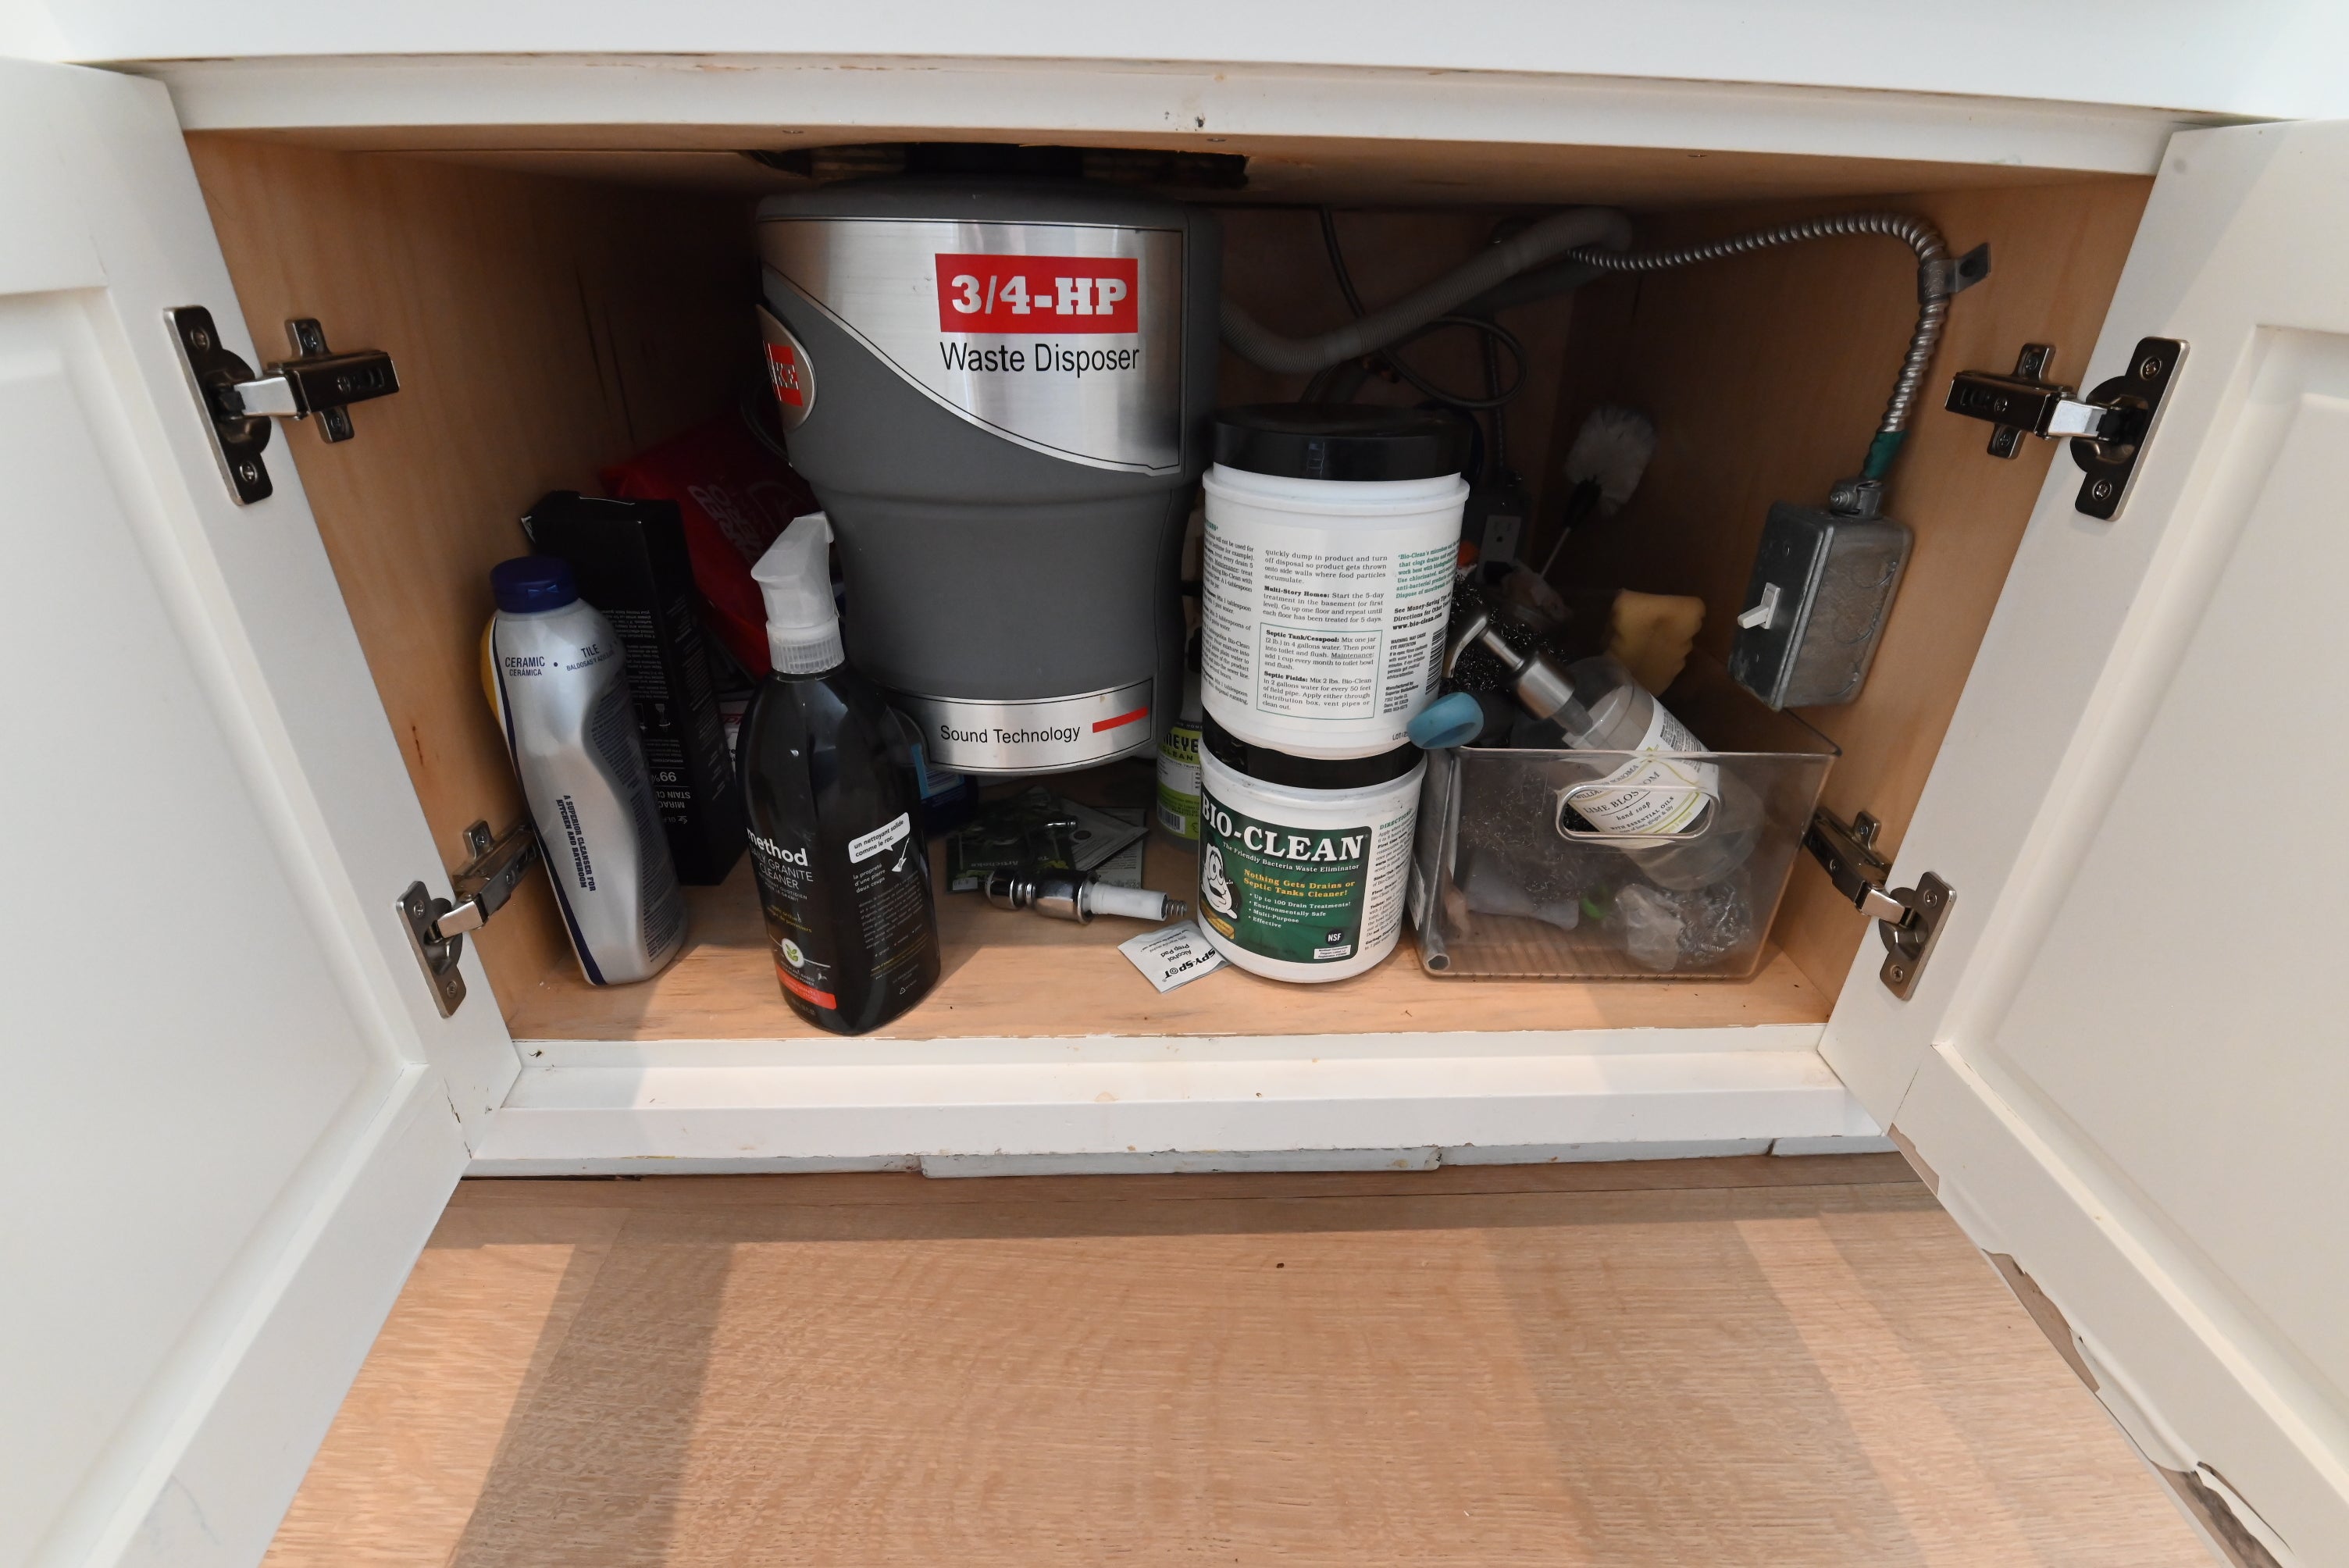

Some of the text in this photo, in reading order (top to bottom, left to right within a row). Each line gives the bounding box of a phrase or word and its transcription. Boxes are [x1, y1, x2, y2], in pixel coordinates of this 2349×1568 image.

[951, 275, 1127, 315] 3/4-HP
[940, 342, 1139, 378] Waste Disposer
[1266, 550, 1289, 558] quickly
[1264, 574, 1304, 583] accumulate.
[1396, 580, 1431, 590] anti-bacterial
[1264, 586, 1301, 597] Multi-Story
[1264, 593, 1295, 604] treatment
[1407, 599, 1440, 611] Money-Saving
[1393, 613, 1423, 622] Directions
[1266, 629, 1286, 638] Septic
[1289, 633, 1339, 643] Tank/Cesspool:
[581, 644, 600, 657] TILE
[505, 657, 545, 668] CERAMIC
[566, 661, 593, 671] BALDOSAS
[940, 725, 1080, 743] Sound Technology
[1584, 804, 1610, 814] LIME
[1616, 801, 1651, 821] hand soap
[1627, 809, 1659, 828] ESSENTIAL
[1660, 796, 1674, 809] OILS
[864, 828, 889, 846] nettoyant
[891, 820, 904, 832] solide
[1202, 792, 1364, 862] BIO-CLEAN
[556, 799, 587, 888] KITCHEN AND BATHROOM
[565, 801, 582, 835] SUPERIOR
[577, 837, 592, 875] CLEANSER
[587, 876, 596, 891] FOR
[747, 828, 808, 866] method
[855, 844, 877, 857] comme
[1223, 841, 1232, 851] The
[1234, 847, 1260, 864] Friendly
[1262, 858, 1292, 870] Bacteria
[1321, 864, 1359, 873] Eliminator
[760, 862, 799, 889] CLEANER
[768, 859, 813, 882] GRANITE
[854, 869, 886, 886] d'une pierre
[860, 863, 882, 879] propreté
[857, 877, 885, 893] deux coups
[1243, 877, 1271, 892] Septic
[1275, 887, 1303, 896] Tanks
[1244, 869, 1279, 886] Nothing
[1284, 880, 1305, 889] Gets
[1253, 902, 1309, 917] Environmentally
[1253, 909, 1299, 923] Multi-Purpose
[1253, 917, 1281, 928] Effective
[1328, 932, 1341, 942] NSF
[1167, 950, 1192, 962] Alcohol
